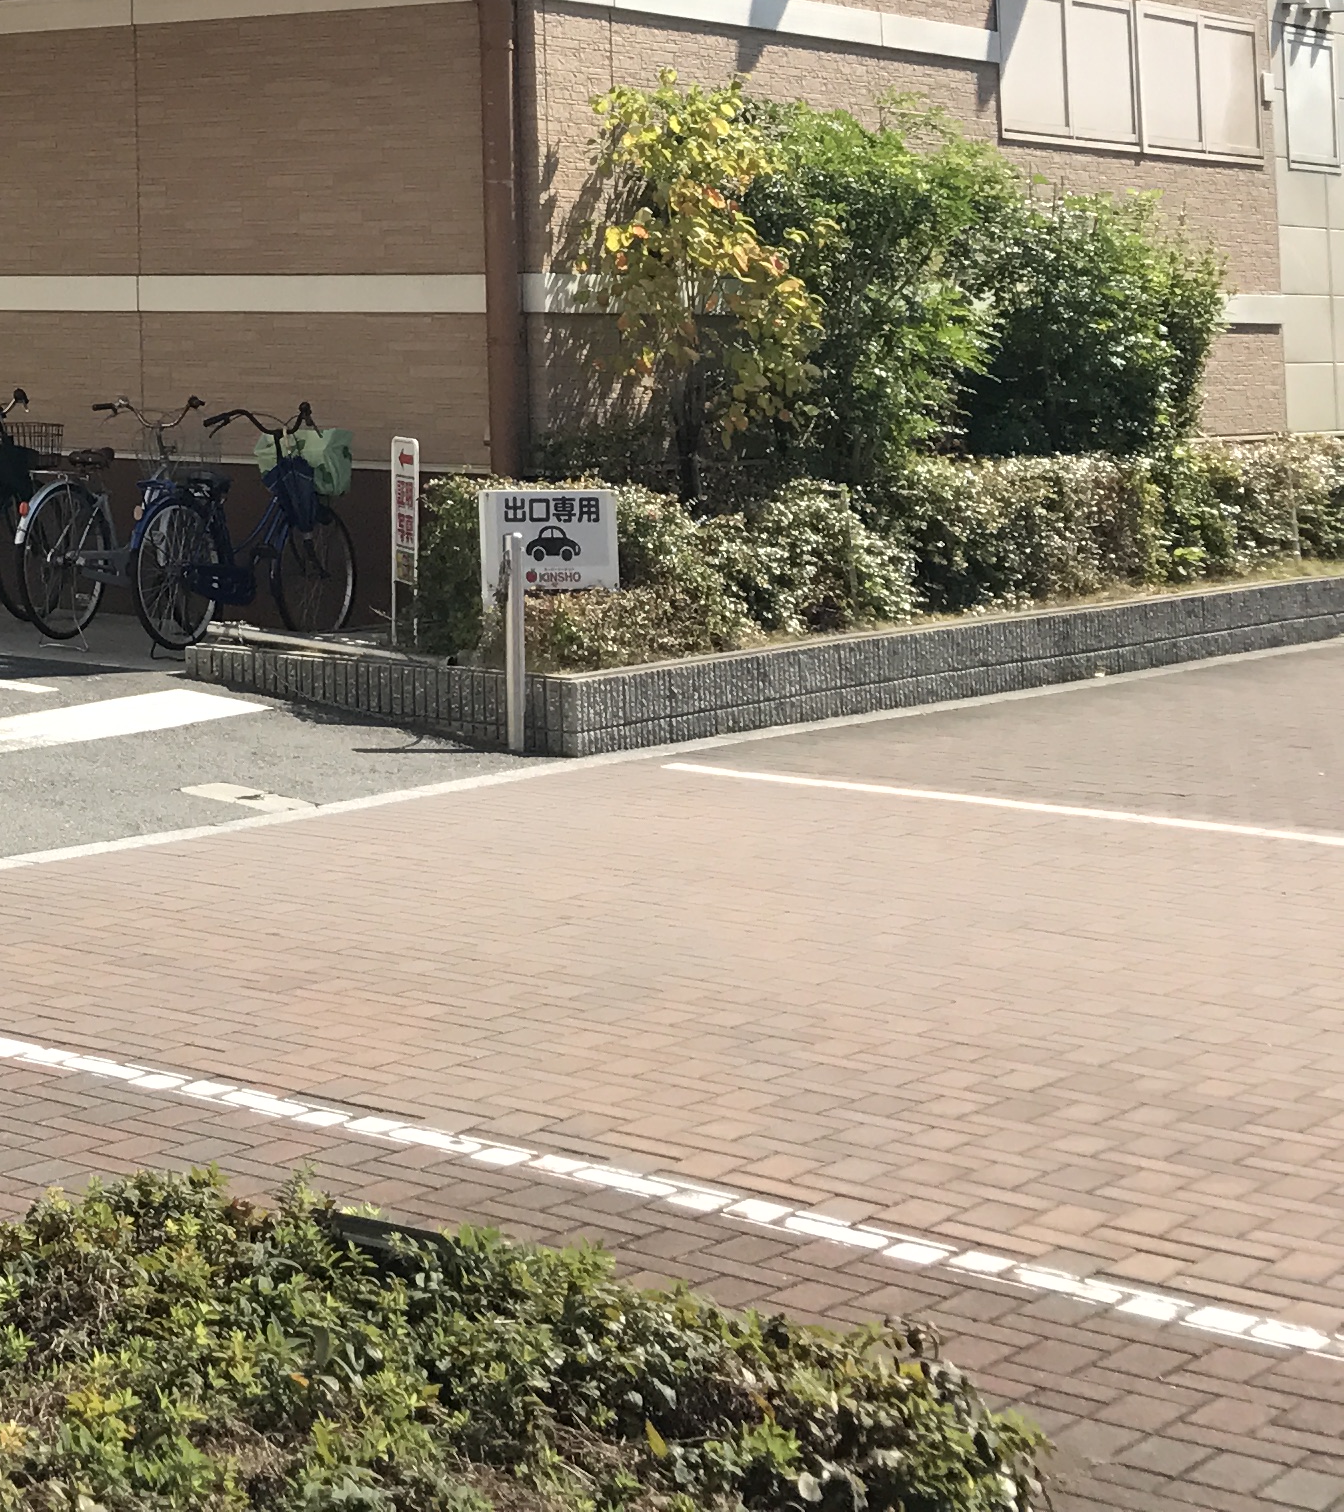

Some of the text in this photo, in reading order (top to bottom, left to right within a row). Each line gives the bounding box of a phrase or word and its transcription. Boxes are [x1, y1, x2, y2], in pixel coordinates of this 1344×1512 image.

[504, 496, 600, 523] 出口専用
[539, 571, 582, 583] KINSHO
